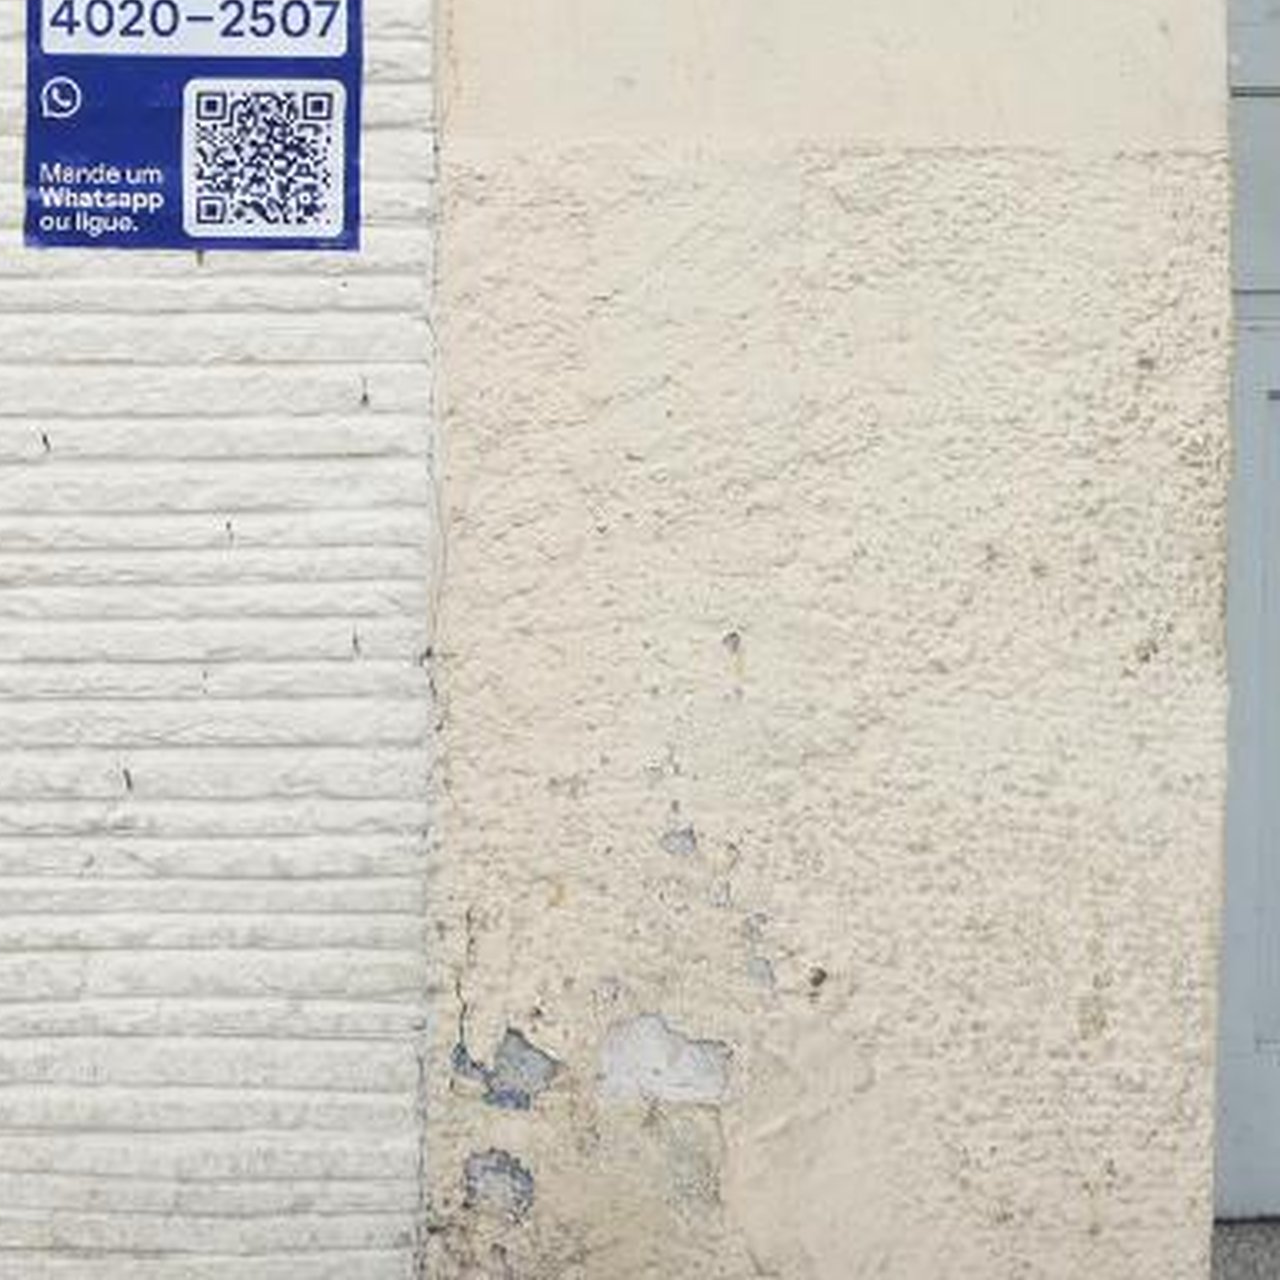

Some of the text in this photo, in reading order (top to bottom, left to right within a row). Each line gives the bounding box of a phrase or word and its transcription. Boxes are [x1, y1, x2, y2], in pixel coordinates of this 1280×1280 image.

[39, 162, 164, 185] Mande um
[38, 186, 166, 214] Whatsapp
[39, 210, 139, 238] ou ligue.
